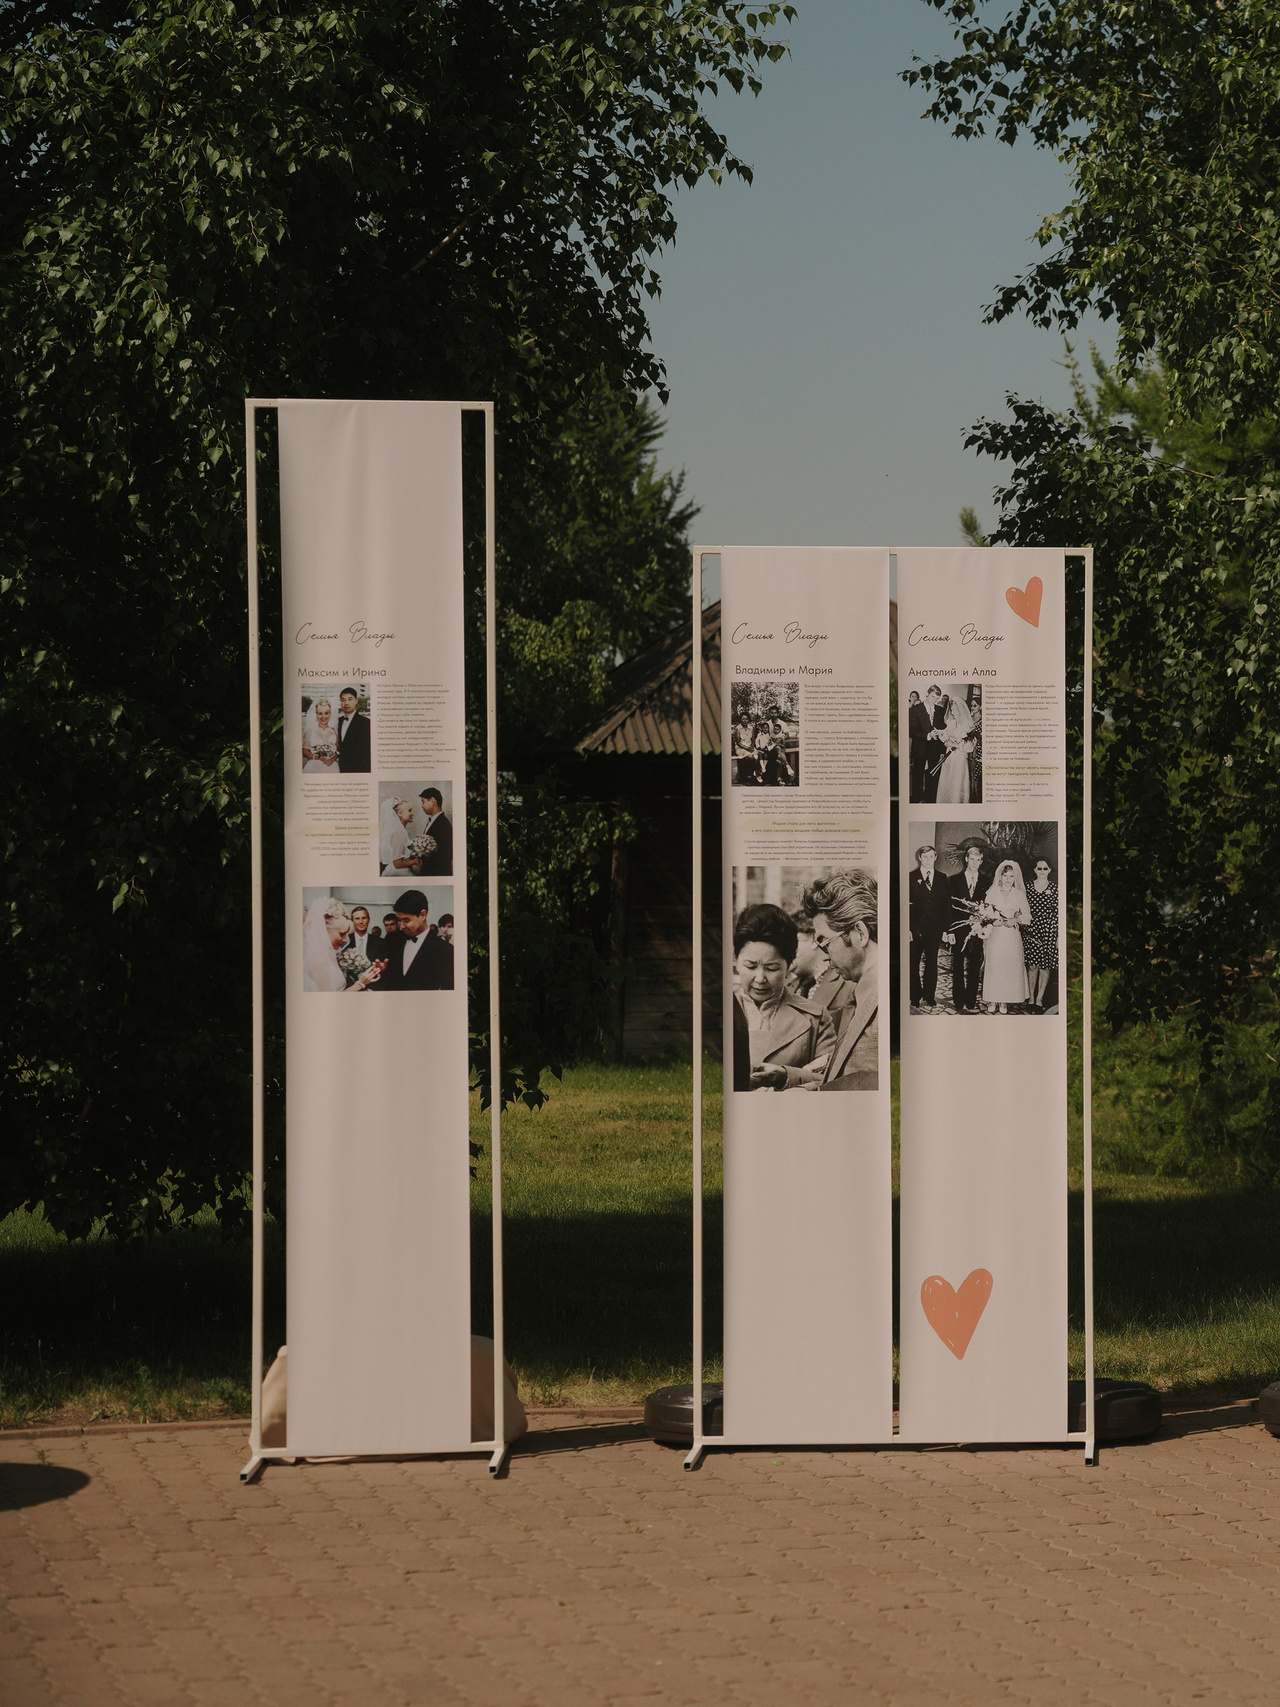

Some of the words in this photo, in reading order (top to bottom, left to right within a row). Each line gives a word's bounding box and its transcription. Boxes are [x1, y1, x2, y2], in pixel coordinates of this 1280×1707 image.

[295, 622, 340, 645] Семья
[349, 620, 396, 648] Влады
[731, 622, 775, 645] Семья
[783, 621, 829, 649] Влады
[907, 623, 951, 647] Семья
[959, 622, 1005, 650] Влады
[297, 668, 340, 678] Максим
[352, 667, 387, 680] Ирина
[735, 665, 786, 678] Владимир
[798, 665, 833, 678] Мария
[908, 667, 957, 677] Анатолий
[962, 669, 969, 677] и
[972, 667, 997, 677] Алла
